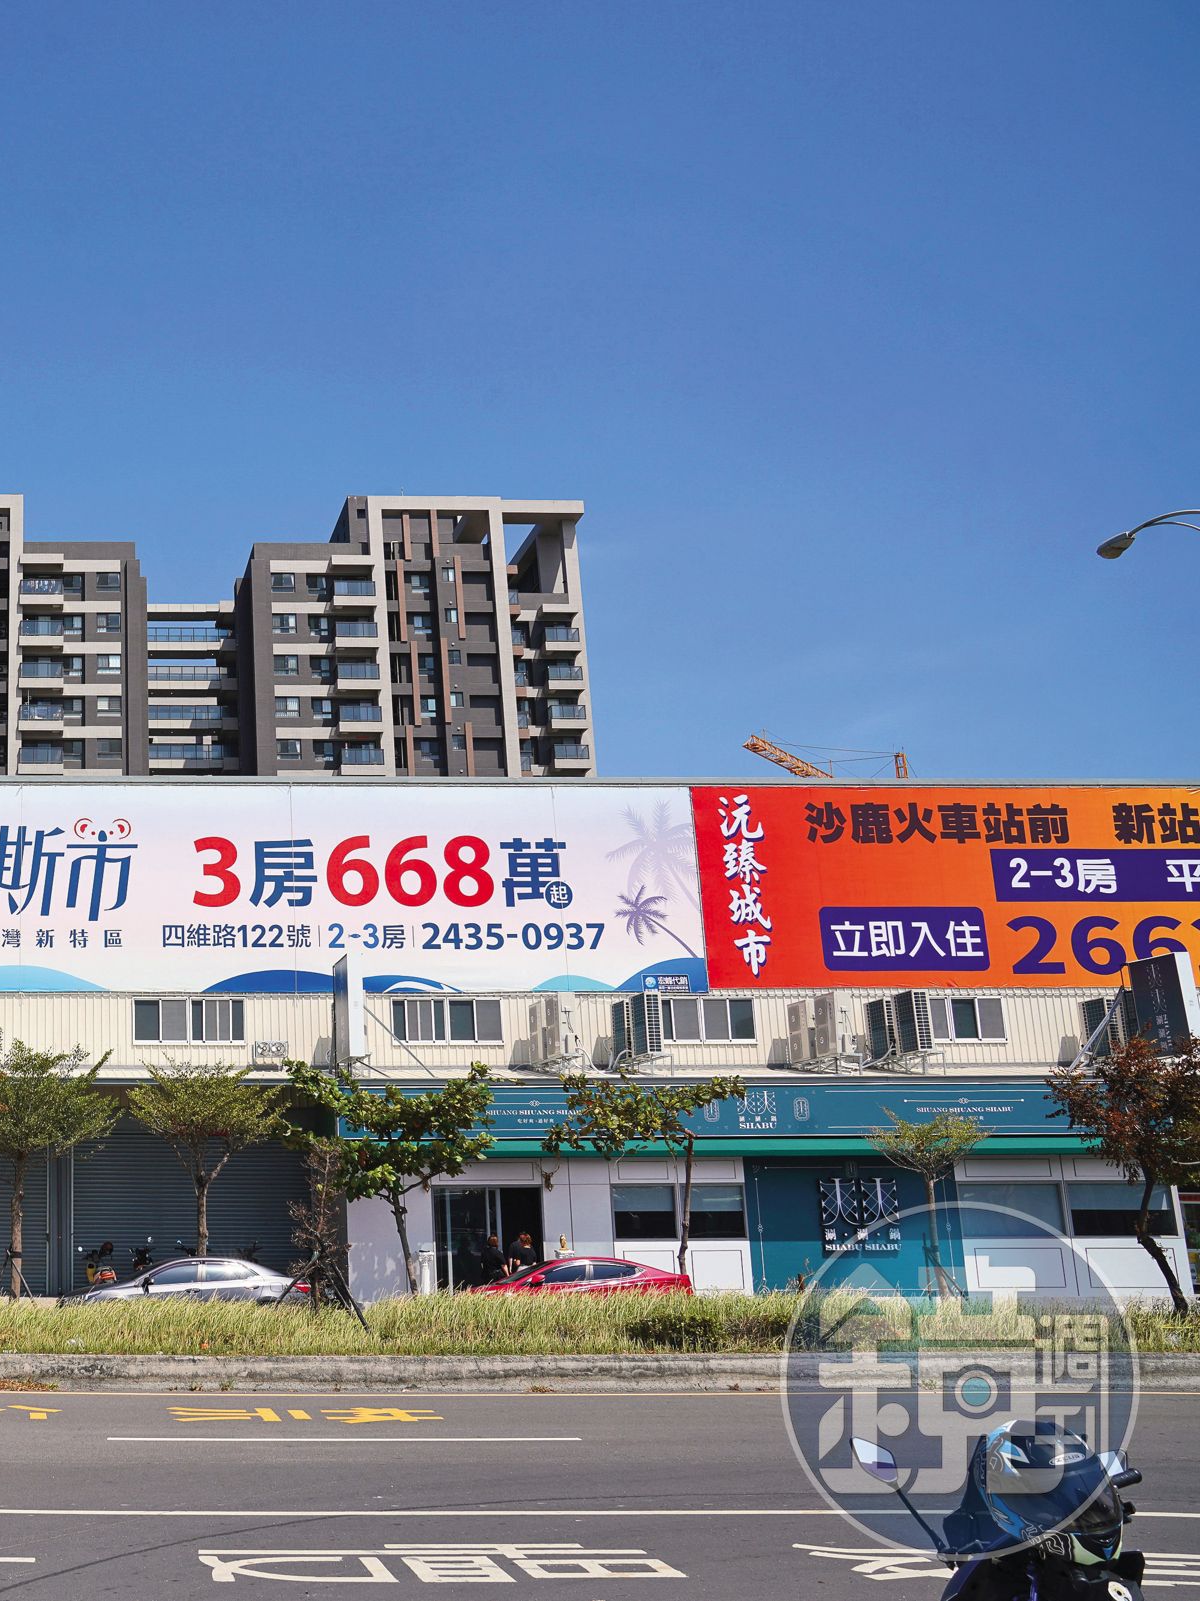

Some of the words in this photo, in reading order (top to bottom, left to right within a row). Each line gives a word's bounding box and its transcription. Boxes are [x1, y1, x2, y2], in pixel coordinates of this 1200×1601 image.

[804, 801, 1070, 845] 沙鹿火車站前
[1010, 856, 1118, 895] 2-3房
[161, 922, 312, 949] 四維路122號
[327, 922, 406, 949] 2-3房
[421, 922, 605, 951] 2435-0937
[829, 919, 985, 958] 立即入住
[1005, 915, 1200, 975] 266
[825, 1243, 863, 1251] SHABU
[865, 1243, 902, 1251] SHABU
